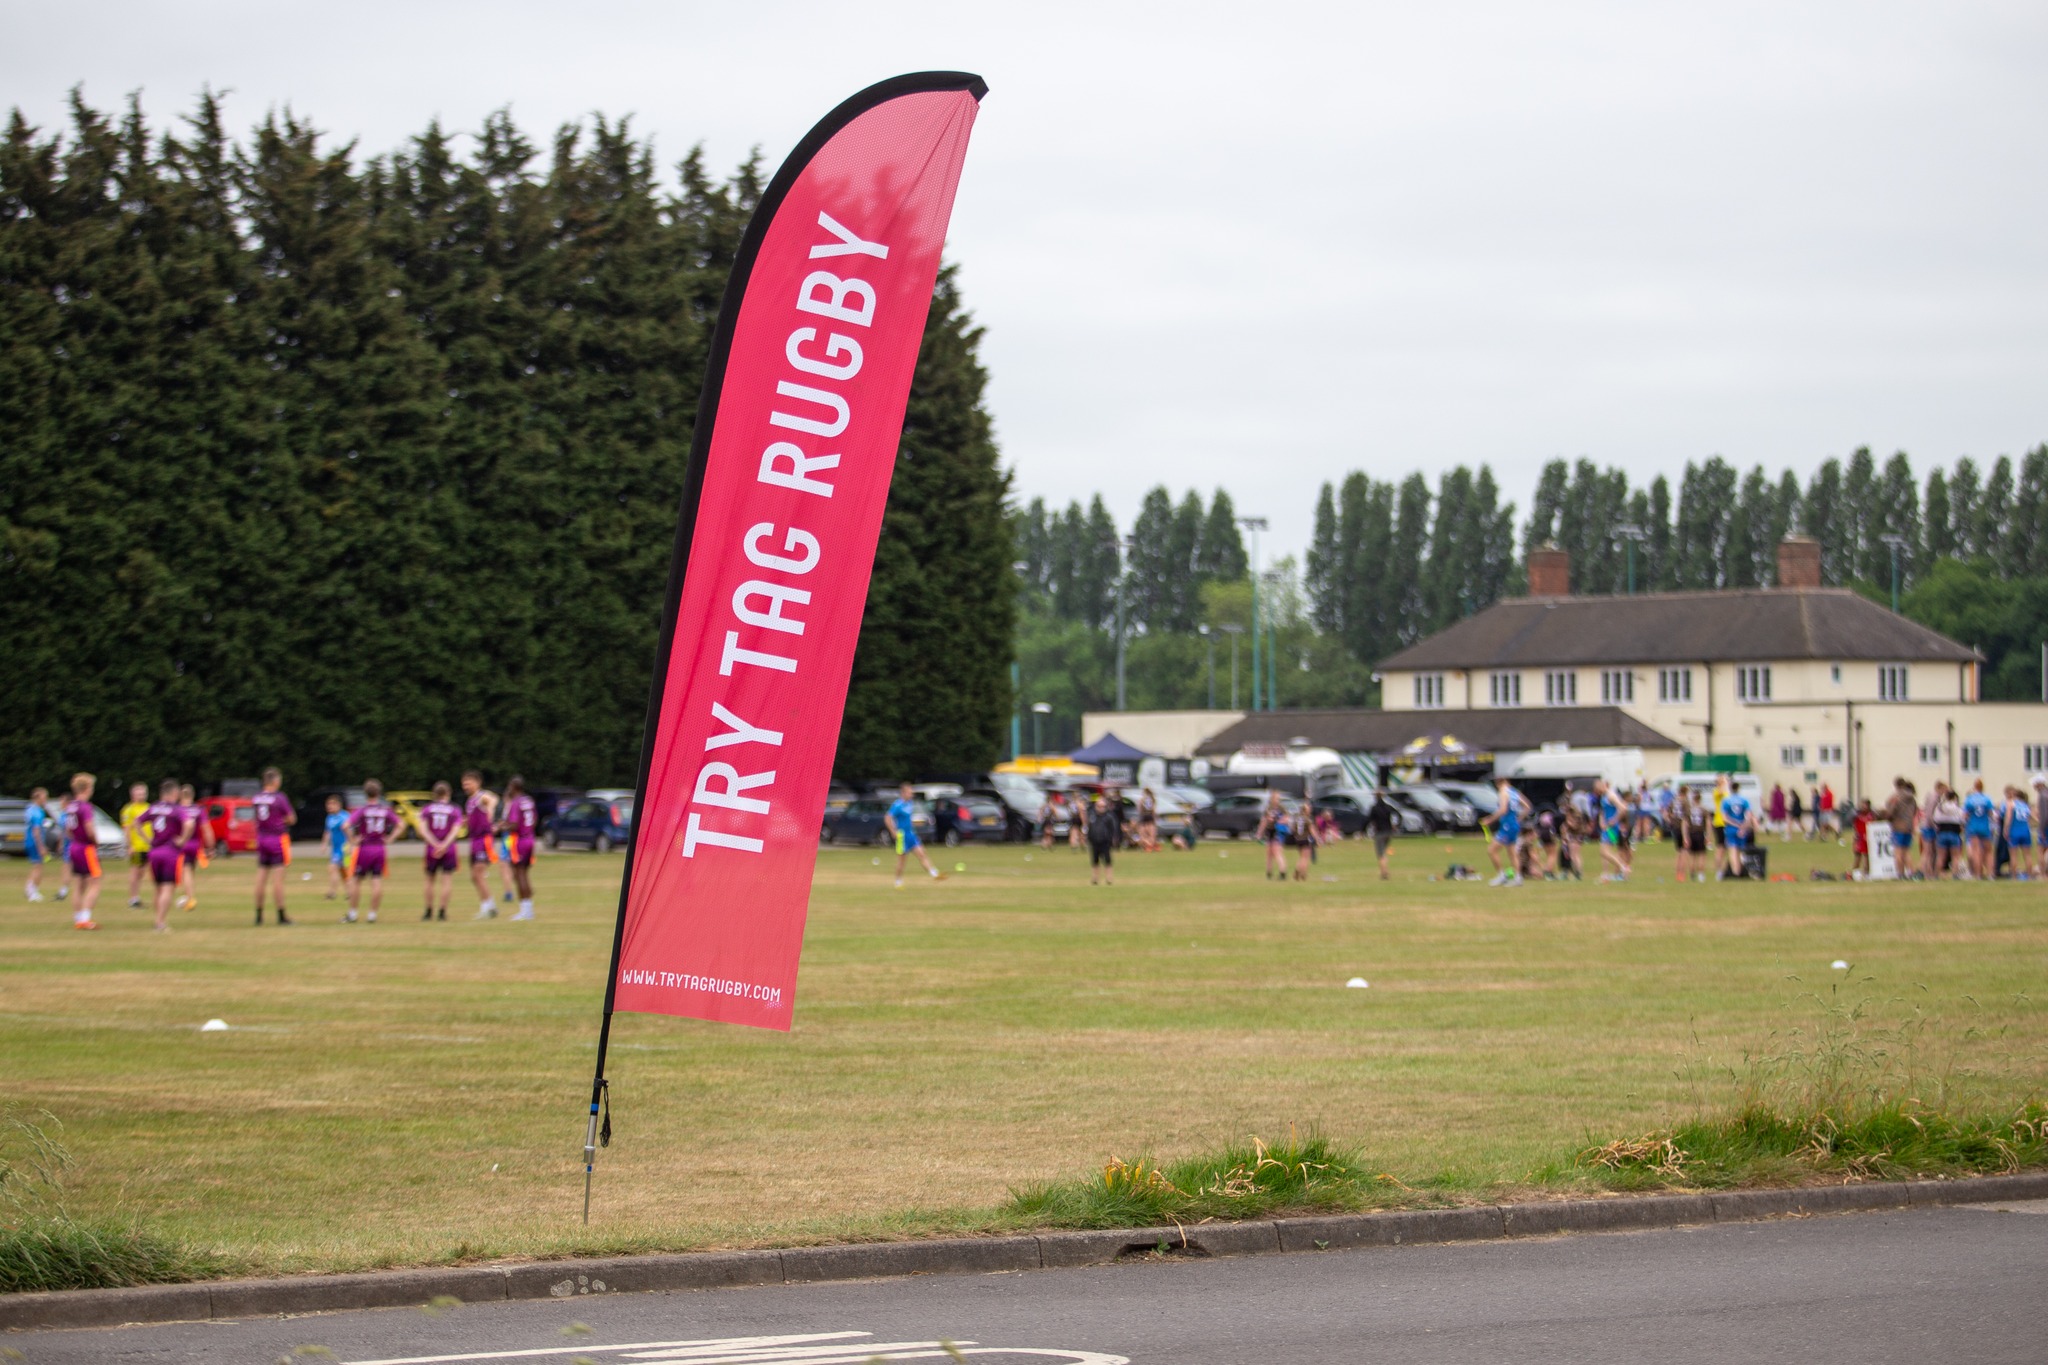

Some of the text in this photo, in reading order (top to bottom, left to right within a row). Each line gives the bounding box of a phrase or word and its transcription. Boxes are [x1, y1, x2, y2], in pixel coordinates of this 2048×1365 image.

[683, 211, 889, 858] TRY TAG RUGBY
[622, 969, 781, 1002] WWW.TRYTAGRUGBY.COM
